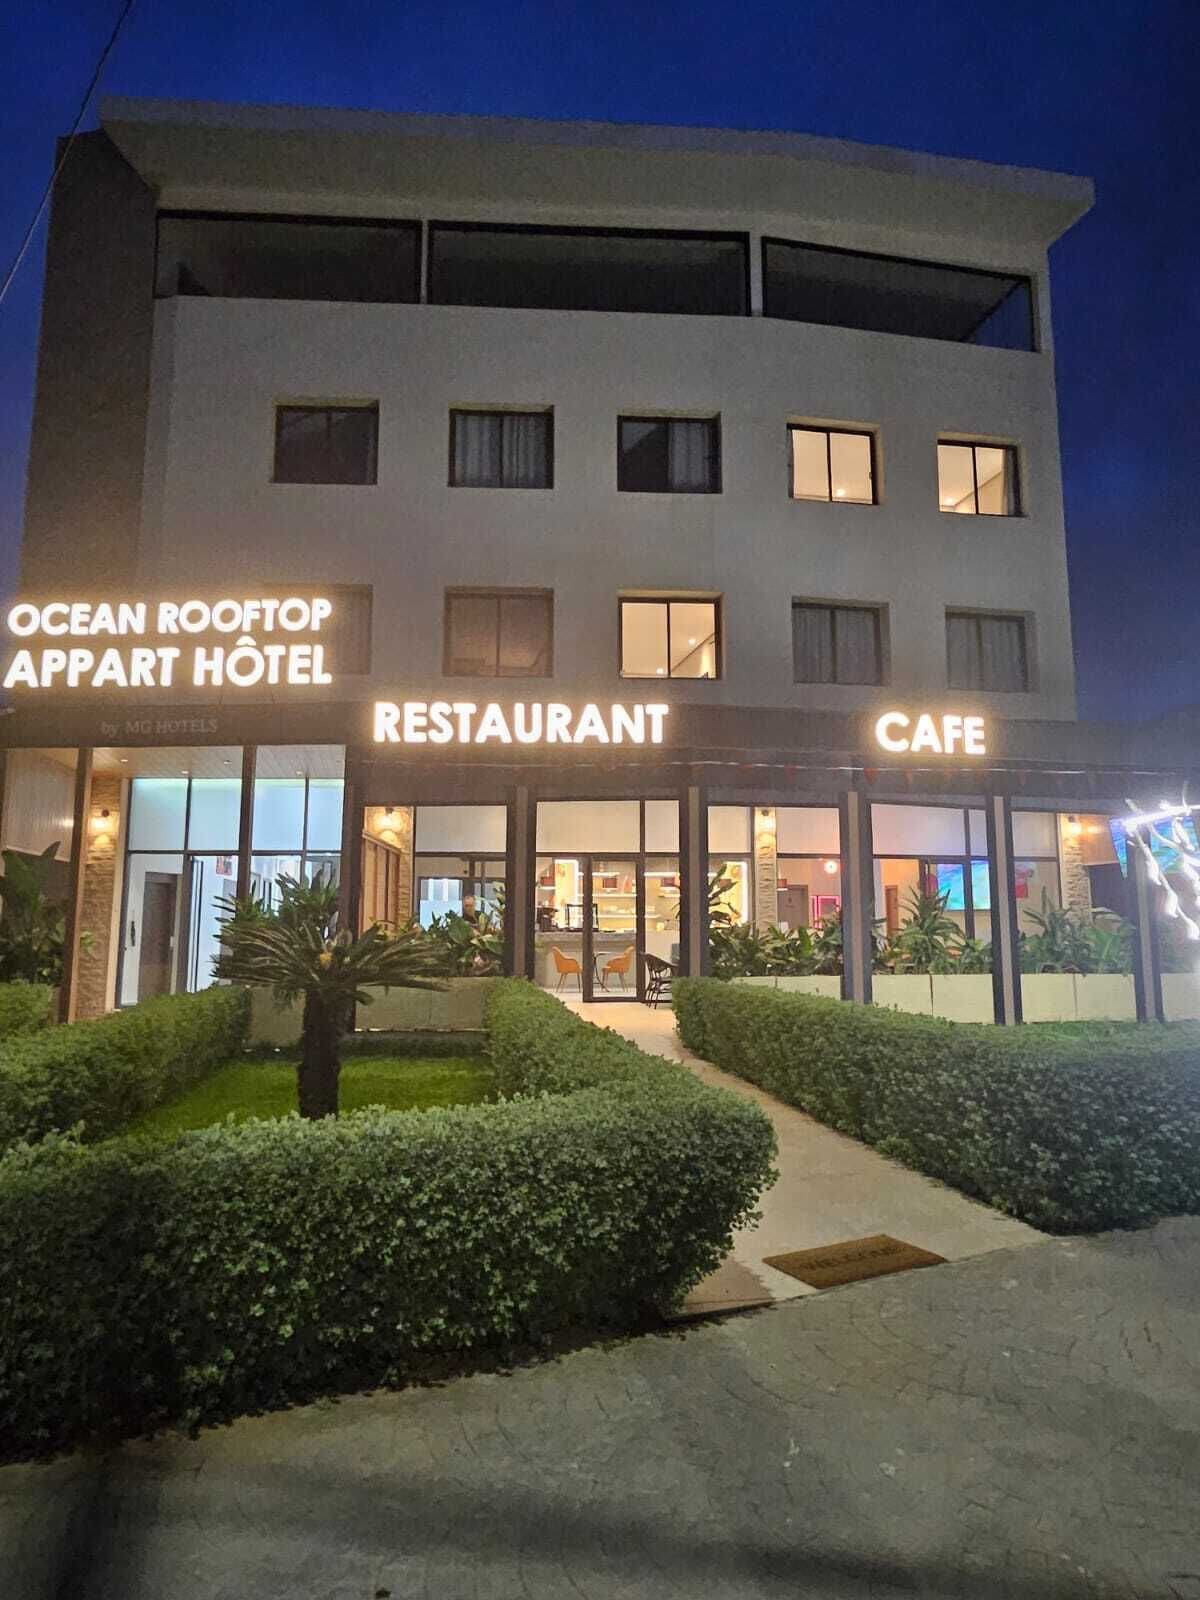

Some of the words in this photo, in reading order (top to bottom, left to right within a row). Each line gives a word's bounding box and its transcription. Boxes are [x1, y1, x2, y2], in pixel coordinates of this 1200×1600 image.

[7, 602, 146, 636] OCEAN
[157, 598, 332, 633] ROOFTOP
[2, 648, 180, 688] APPART
[193, 635, 332, 687] HÔTEL
[101, 720, 120, 737] by
[126, 720, 152, 734] MG
[156, 718, 218, 734] HOTELS
[373, 701, 669, 743] RESTAURANT
[875, 712, 986, 755] CAFE
